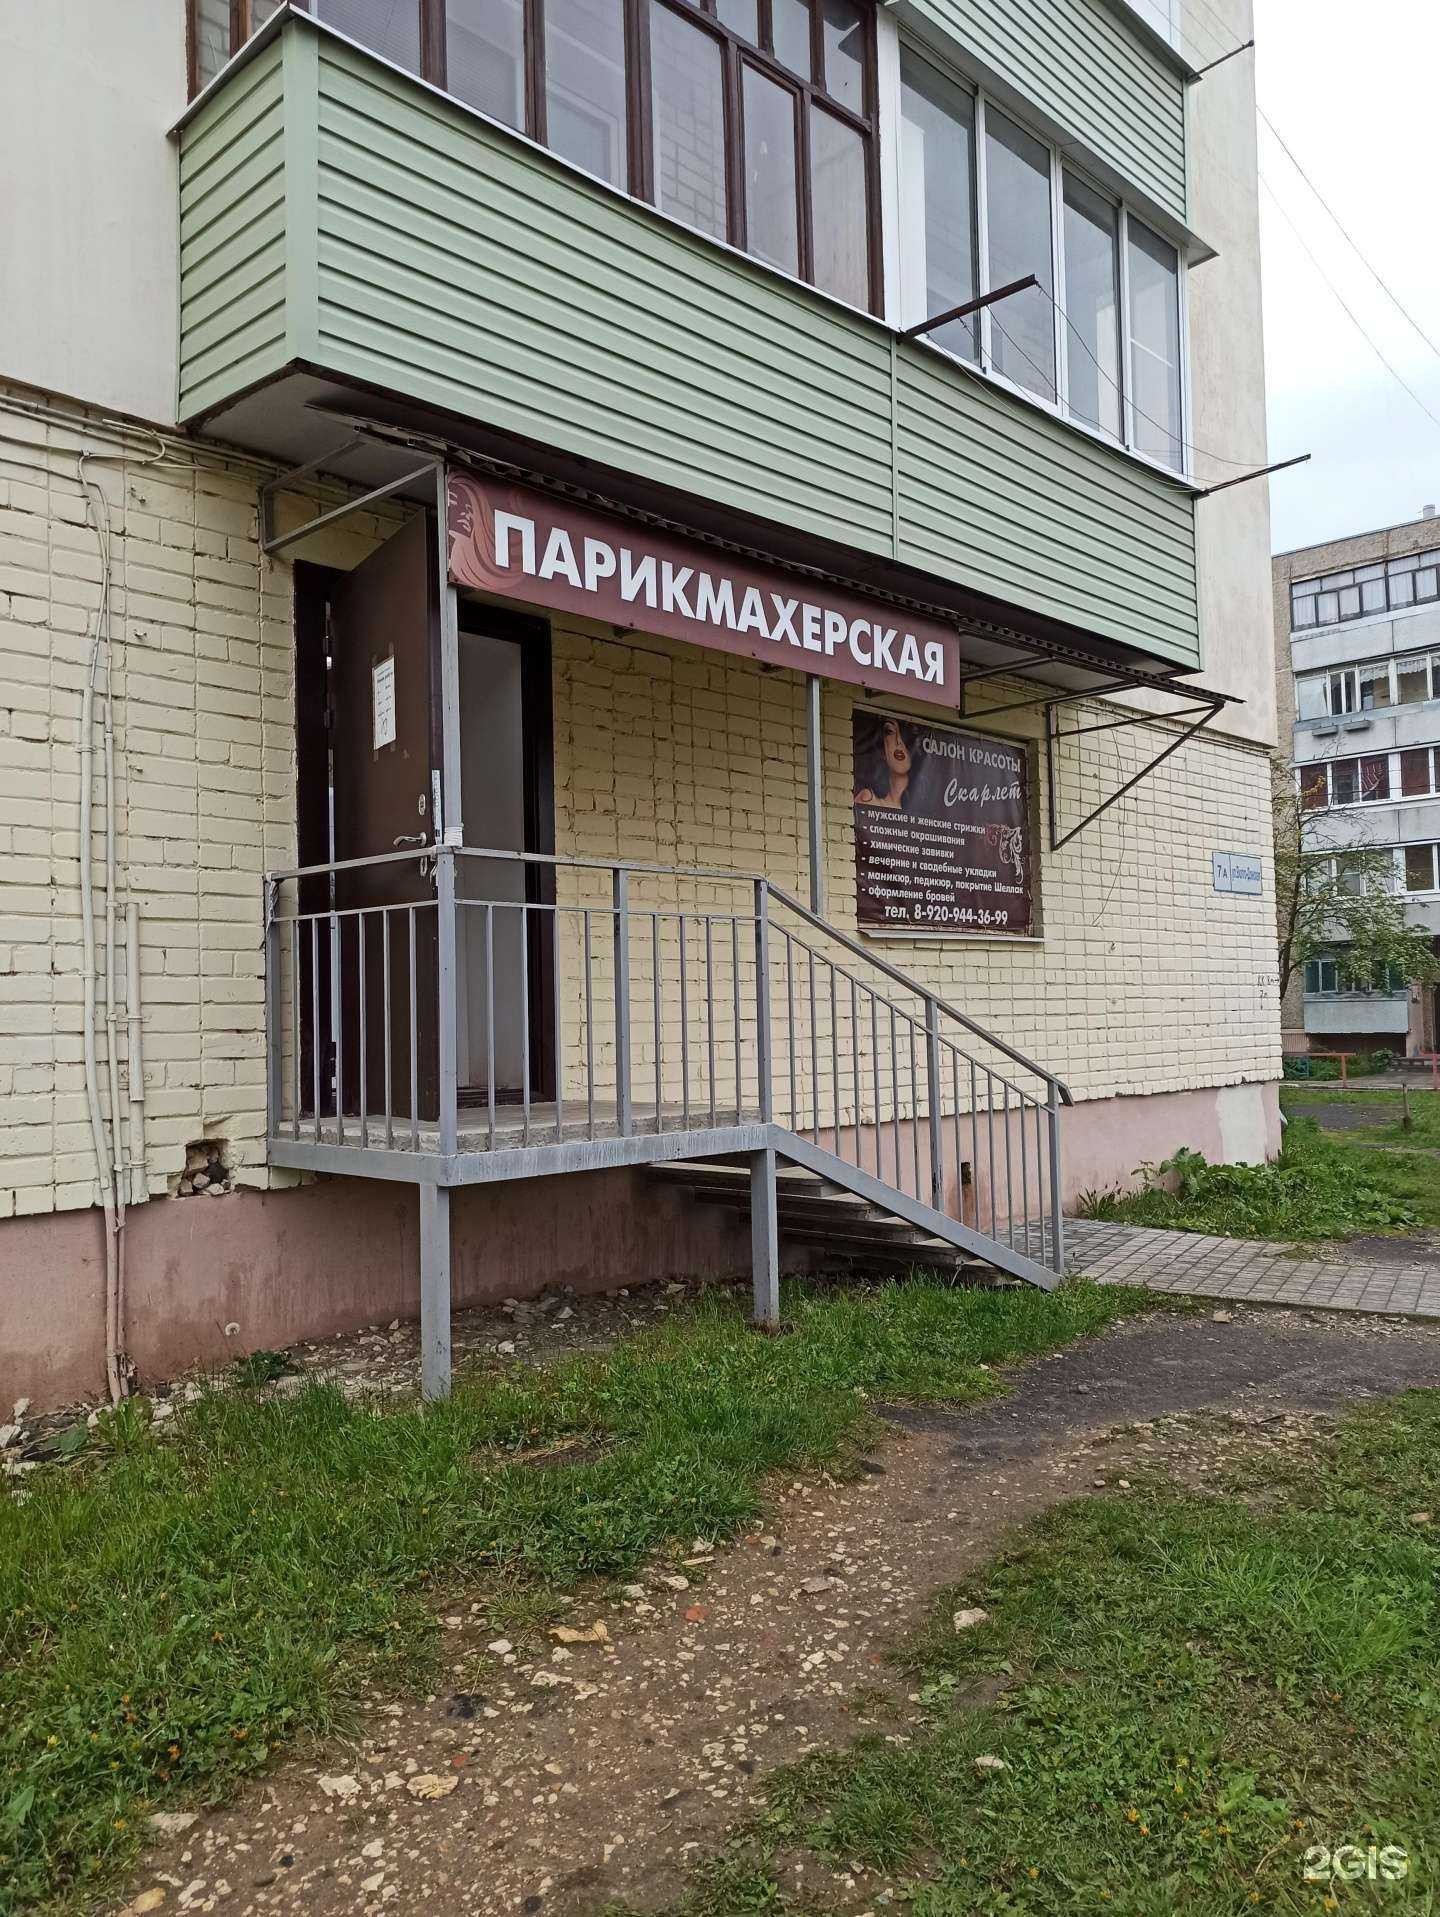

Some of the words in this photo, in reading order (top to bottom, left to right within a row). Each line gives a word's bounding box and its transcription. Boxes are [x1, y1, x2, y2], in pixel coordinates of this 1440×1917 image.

[494, 509, 945, 685] ПАРИКМАХЕРСКАЯ
[922, 738, 965, 761] САЛОН
[969, 747, 1020, 773] КРАСОТЫ
[944, 778, 1022, 808] Скарлет
[867, 810, 909, 823] мужские
[917, 816, 952, 829] женские
[953, 822, 986, 835] стрижки
[869, 825, 909, 837] сложные
[911, 830, 965, 846] окрашивания
[870, 840, 920, 854] химические
[921, 847, 954, 859] завивки
[868, 856, 910, 868] вечерние
[919, 861, 963, 875] свадебные
[965, 867, 997, 879] укладки
[867, 871, 912, 885] маникюр,
[914, 876, 954, 890] педикюр,
[955, 880, 993, 892] покрытие
[994, 882, 1024, 894] Шеллак
[868, 885, 924, 899] оформление
[925, 889, 955, 903] бровей
[884, 905, 910, 919] тел.
[914, 903, 1008, 925] 8-920-944-36-99
